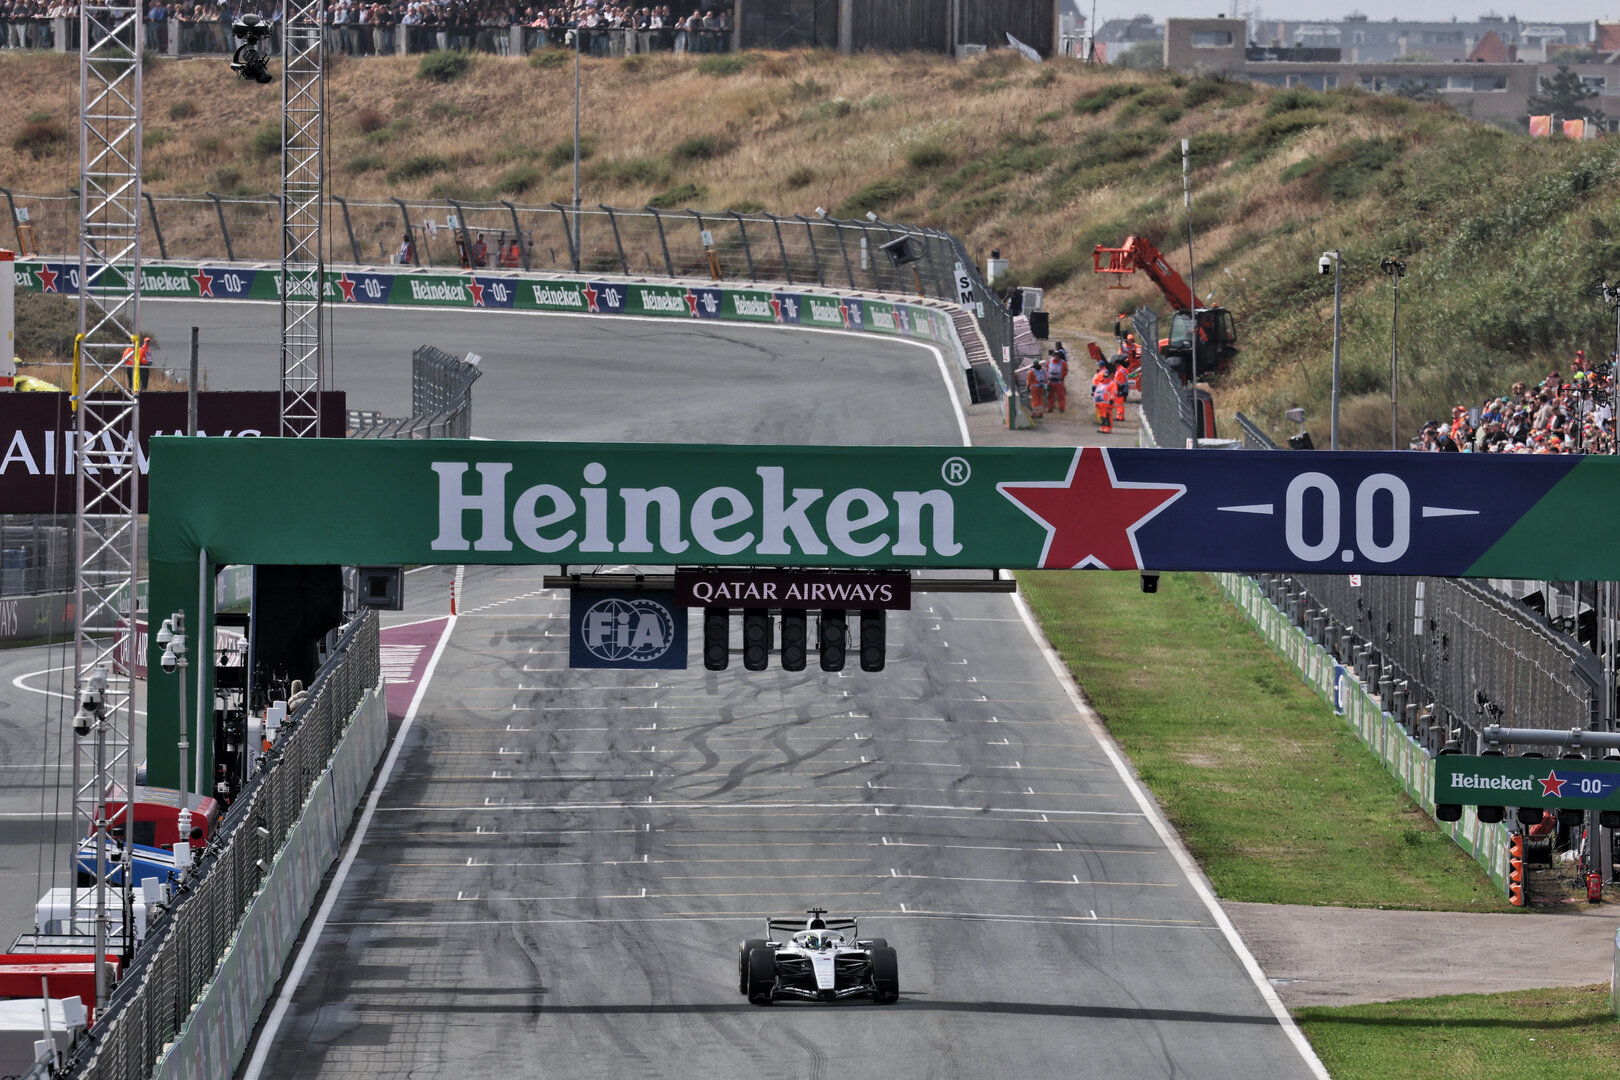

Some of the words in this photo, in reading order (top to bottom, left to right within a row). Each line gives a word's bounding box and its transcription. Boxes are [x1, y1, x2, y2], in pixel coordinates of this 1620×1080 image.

[410, 280, 467, 301] Heineken
[532, 285, 582, 306] Heineken
[640, 289, 685, 312] Heineken
[1285, 471, 1411, 564] 0.0
[692, 581, 777, 602] QATAR
[785, 583, 893, 602] AIRWAYS
[0, 600, 18, 636] AYS
